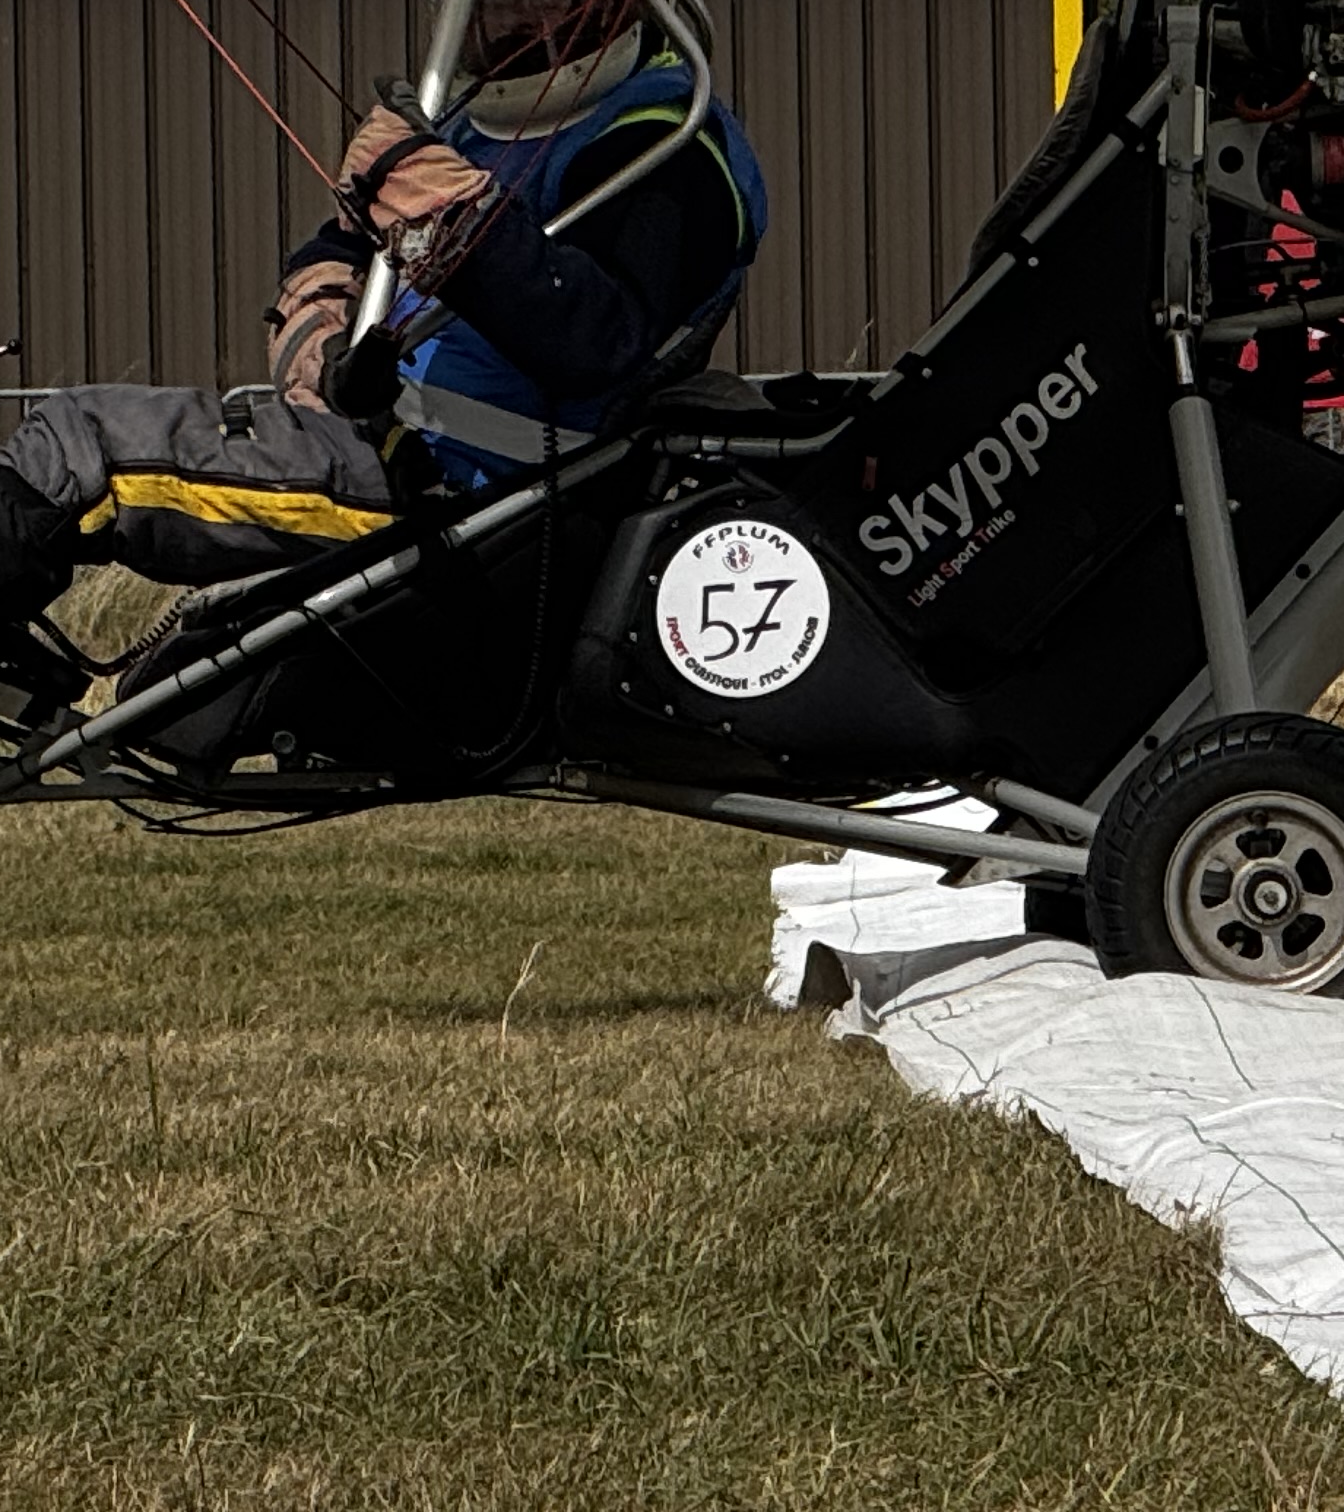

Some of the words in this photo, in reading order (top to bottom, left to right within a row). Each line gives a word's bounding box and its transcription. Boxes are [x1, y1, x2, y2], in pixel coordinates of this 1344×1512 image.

[859, 343, 1099, 576] Skypper
[692, 526, 790, 559] FFPLUM
[907, 574, 946, 608] Light
[939, 541, 981, 578] Sport
[975, 509, 1016, 543] Trike
[699, 579, 798, 662] 57
